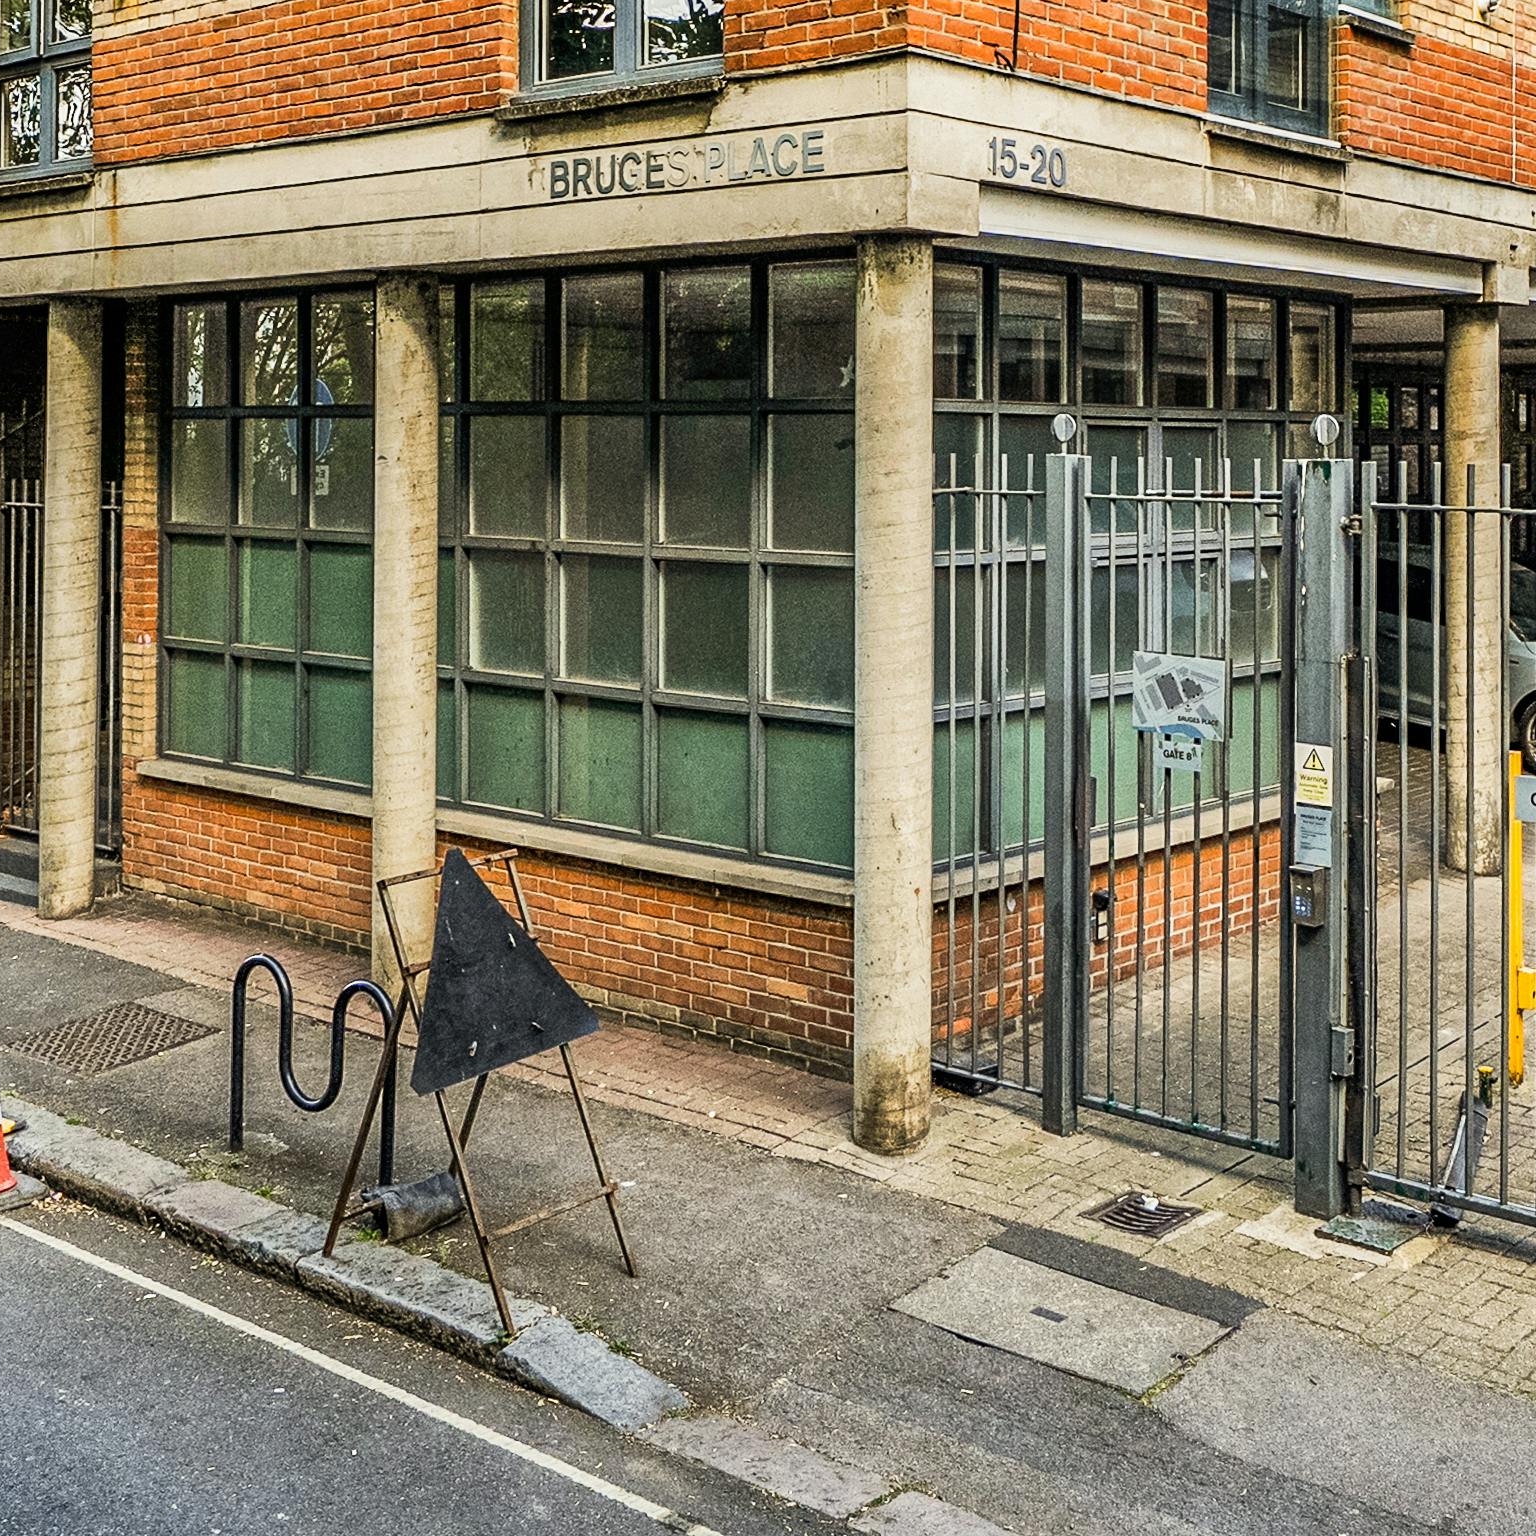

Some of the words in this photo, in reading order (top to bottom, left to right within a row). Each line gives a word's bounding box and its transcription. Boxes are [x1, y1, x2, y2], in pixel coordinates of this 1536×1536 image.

[550, 145, 690, 199] BRUGES
[703, 130, 825, 183] PLACE
[989, 137, 1065, 187] 15-20
[1177, 715, 1201, 724] BRUGES
[1163, 749, 1185, 760] GATE
[1186, 752, 1193, 761] 8
[1300, 774, 1328, 785] Warning
